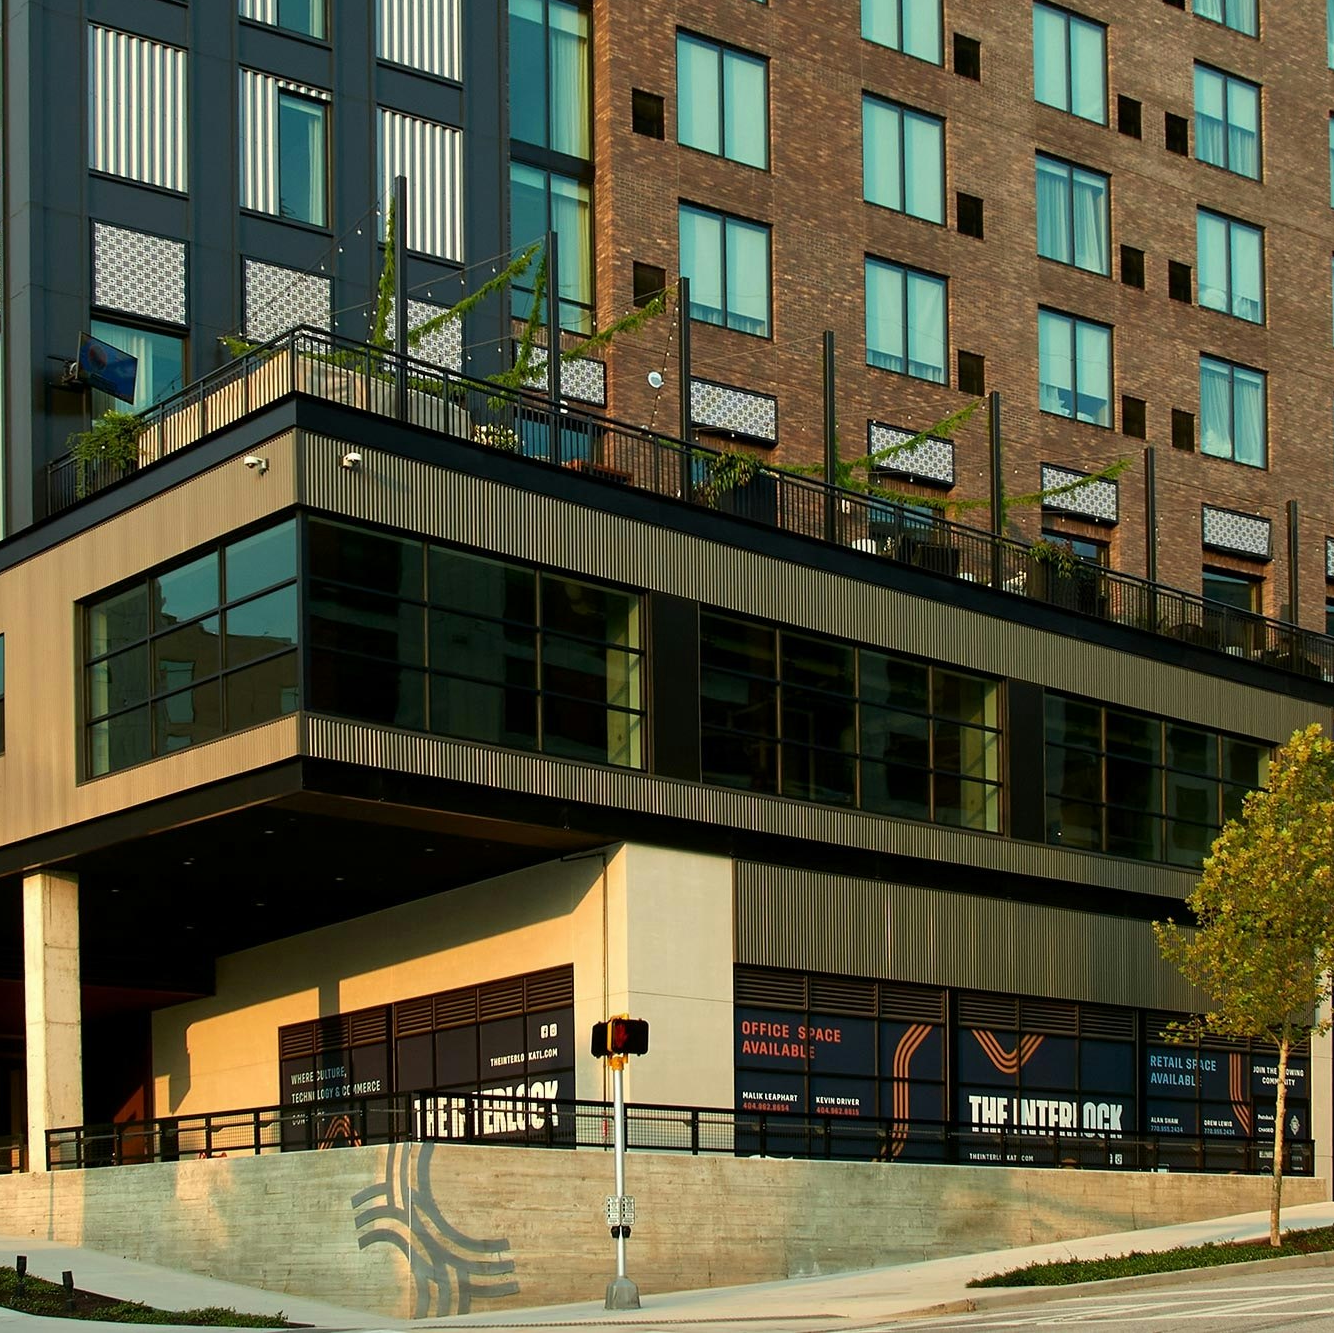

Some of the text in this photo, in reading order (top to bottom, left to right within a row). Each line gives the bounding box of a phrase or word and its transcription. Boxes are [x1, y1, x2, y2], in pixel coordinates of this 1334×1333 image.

[742, 1020, 842, 1043] OFFICE SPACE
[742, 1040, 816, 1059] AVAILABLE
[490, 1048, 558, 1067] THEINTERLOKATL.COM
[1150, 1054, 1217, 1072] RETAIL SPACE
[1253, 1065, 1266, 1074] JOIN
[1267, 1066, 1277, 1075] THE
[290, 1071, 314, 1085] WHERE
[1150, 1072, 1203, 1087] AVAILABL
[334, 1086, 340, 1097] &
[742, 1091, 798, 1102] MALIK LEAPHART
[816, 1096, 860, 1106] KEVIN DRIVER
[451, 1080, 559, 1139] INTERLOCK
[969, 1095, 1123, 1139] THE INTERLOCK
[1151, 1116, 1164, 1124] ALAN
[969, 1152, 1034, 1162] THEINTERLKATCOM
